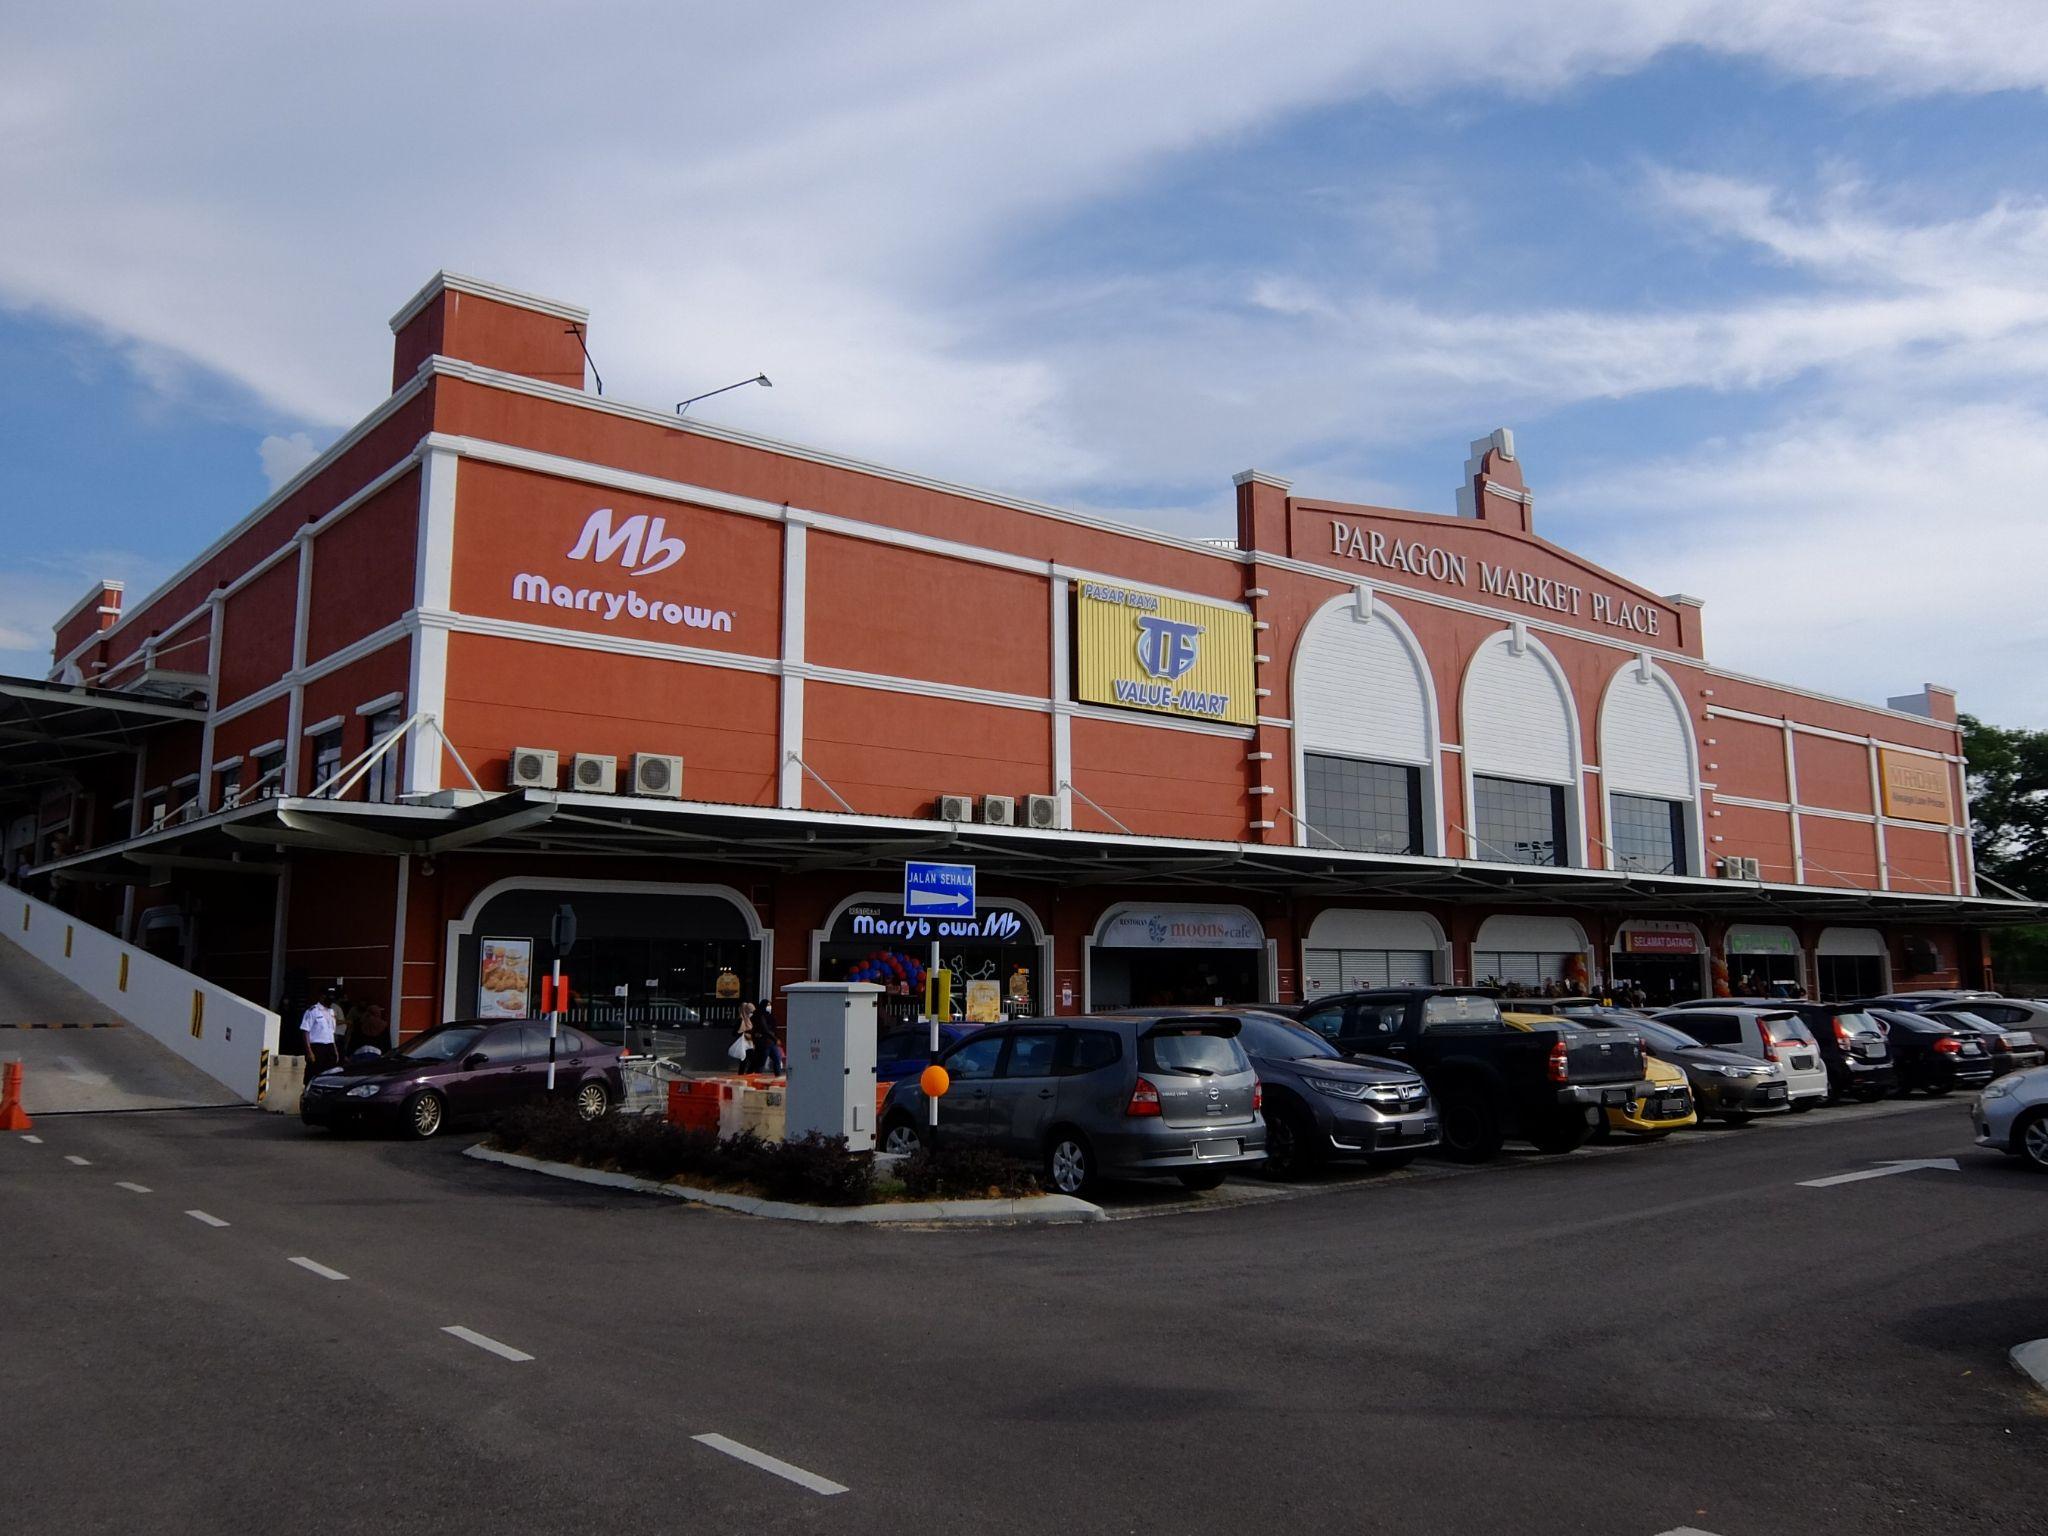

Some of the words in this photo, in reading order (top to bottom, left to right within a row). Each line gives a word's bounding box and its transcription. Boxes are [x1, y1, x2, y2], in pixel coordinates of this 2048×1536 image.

[1330, 520, 1467, 586] PARAGON
[1479, 561, 1582, 616] MARKET
[1590, 592, 1660, 636] PLACE
[1084, 584, 1124, 603] PASAR
[1129, 592, 1158, 610] RAYA
[1115, 680, 1228, 716] VALUE-MART
[908, 872, 937, 885] JALAN
[940, 872, 973, 886] SEHALA
[1170, 922, 1224, 937] moons
[1633, 936, 1665, 947] SELAMAT
[1666, 937, 1693, 948] DATANG
